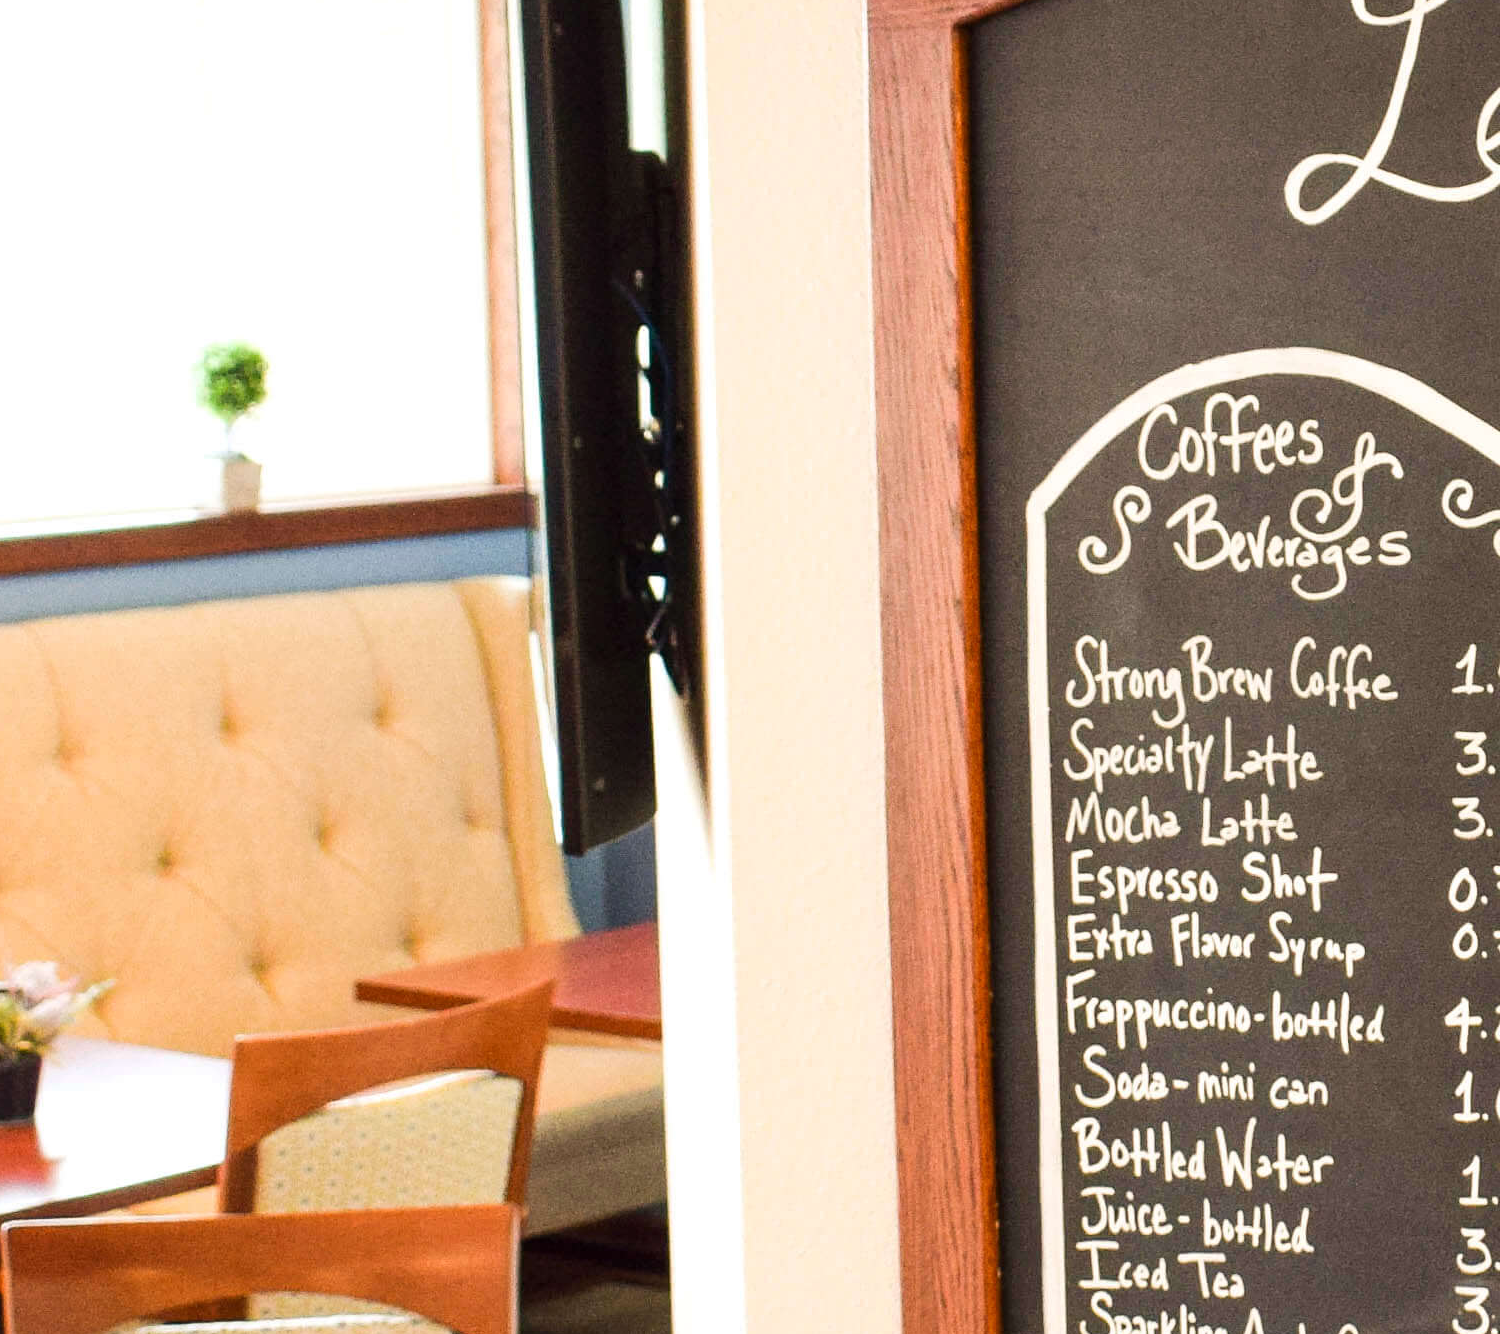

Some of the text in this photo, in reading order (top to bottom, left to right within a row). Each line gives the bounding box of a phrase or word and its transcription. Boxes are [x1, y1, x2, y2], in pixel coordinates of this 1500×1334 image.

[1138, 391, 1324, 481] Coffees
[1166, 493, 1411, 601] Beverages
[1066, 635, 1186, 729] Strong
[1182, 635, 1272, 702] Brew
[1290, 636, 1398, 709] Coffee
[1062, 717, 1212, 793] Specialty
[1224, 717, 1323, 790] Latte
[1065, 791, 1181, 843] Mocha
[1201, 794, 1298, 846] Latte
[1071, 849, 1218, 915] Espresso
[1241, 847, 1338, 912] Shot
[1067, 913, 1153, 962] Extra
[1171, 912, 1255, 966] Flavor
[1269, 911, 1365, 978] Syrup
[1198, 1062, 1255, 1103] mini
[1270, 1077, 1328, 1109] can
[1071, 1117, 1206, 1182] Bottled
[1216, 1117, 1334, 1191] Water
[1076, 1240, 1169, 1291] Iced
[1177, 1253, 1244, 1298] Tea
